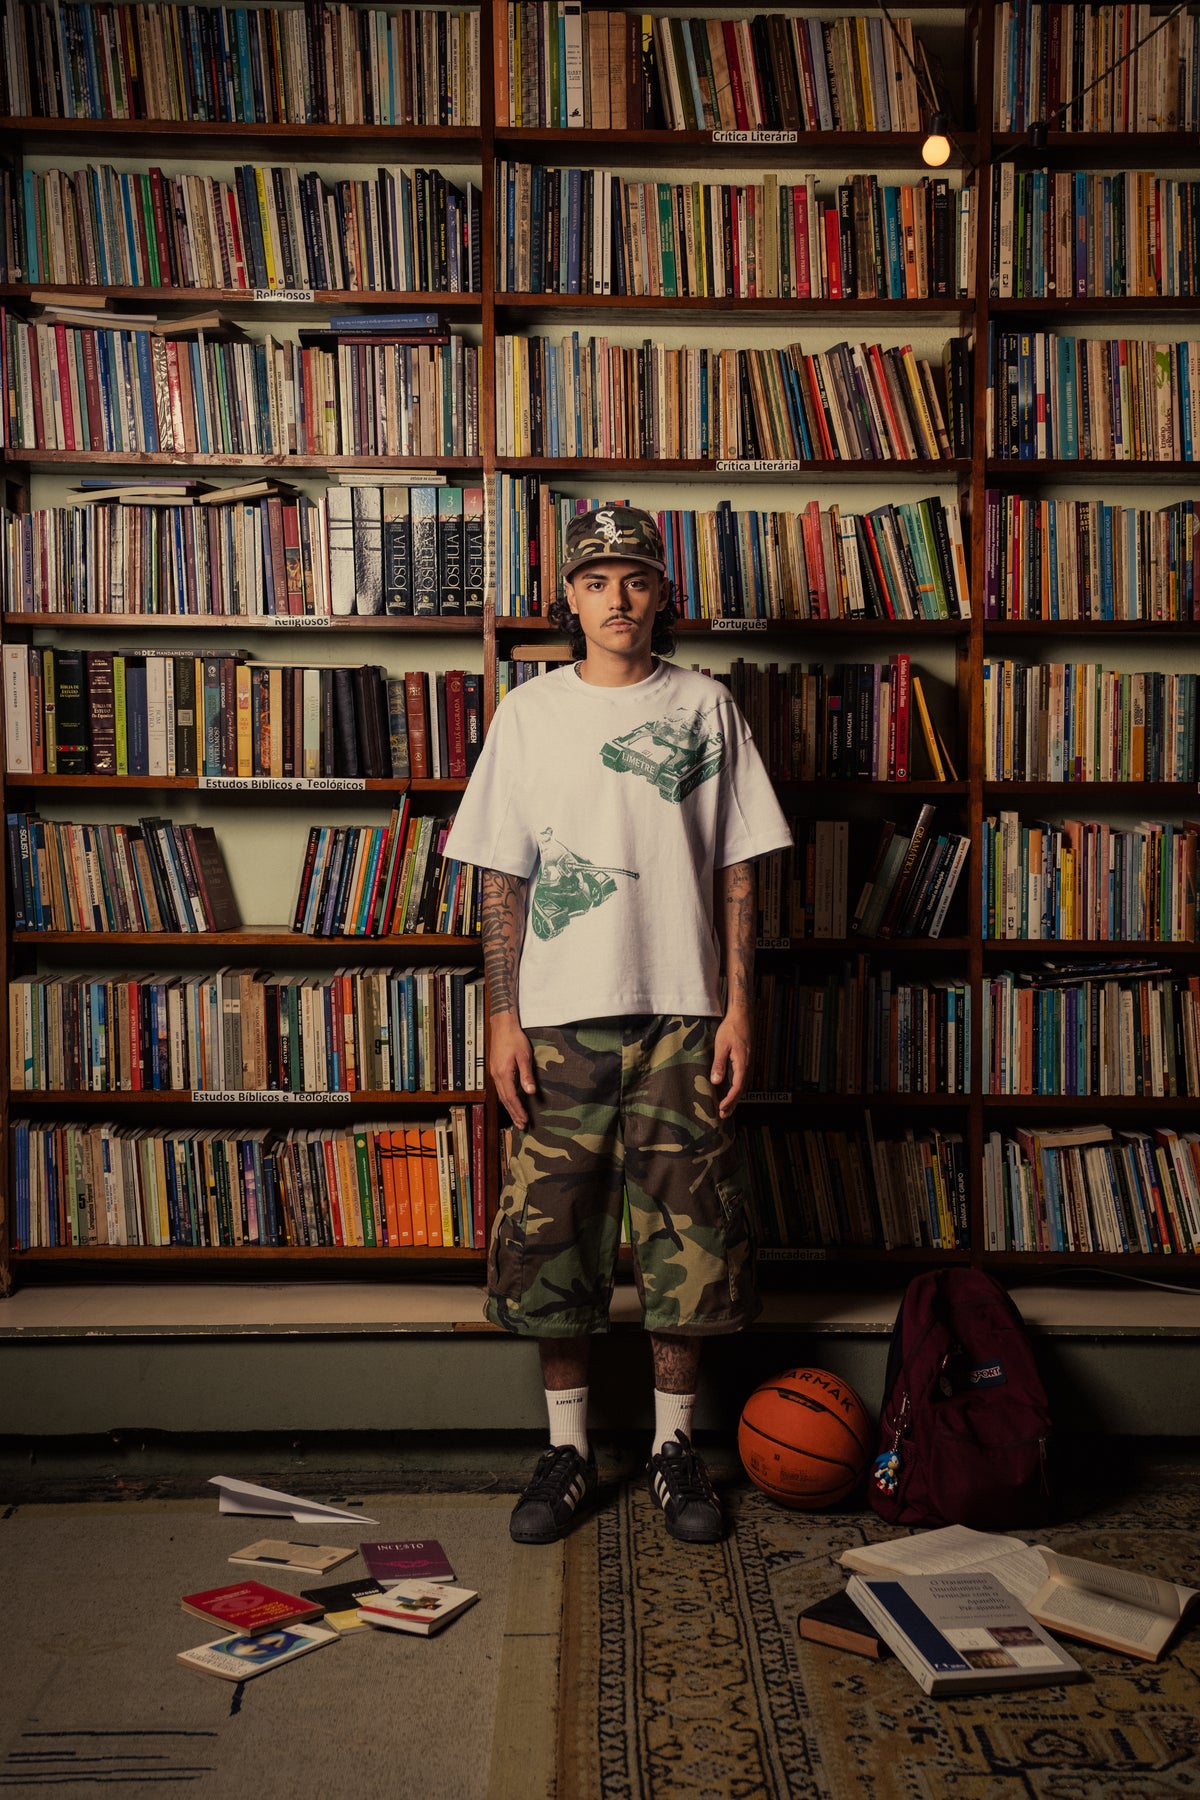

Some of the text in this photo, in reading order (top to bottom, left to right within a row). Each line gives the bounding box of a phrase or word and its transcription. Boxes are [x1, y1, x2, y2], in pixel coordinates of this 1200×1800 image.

[713, 130, 796, 142] Crítica Literária
[417, 191, 423, 202] DA
[256, 290, 311, 301] Religiosos
[717, 461, 798, 471] Crítica Literária
[447, 496, 454, 506] 3
[470, 496, 477, 506] 4
[388, 534, 407, 592] JOSHUA
[416, 535, 435, 593] JOSHUA
[441, 533, 461, 591] JOSHUA
[465, 533, 483, 591] JOSHUA
[712, 619, 767, 631] Português
[621, 751, 656, 776] LIMETRE
[206, 779, 248, 788] Estudos
[251, 780, 292, 790] Bíblicos
[306, 779, 363, 791] Teológicos
[19, 828, 28, 859] SOLISTA
[903, 826, 925, 874] GRAMÁTICA
[757, 938, 789, 949] dação
[193, 1091, 237, 1101] Estudos
[238, 1091, 280, 1102] Bíblicos
[293, 1092, 350, 1103] Teológicos
[959, 1194, 965, 1202] DE
[759, 1248, 825, 1260] Brincadeiras
[969, 1366, 1001, 1383] SPORT
[377, 1542, 424, 1551] INCESTO
